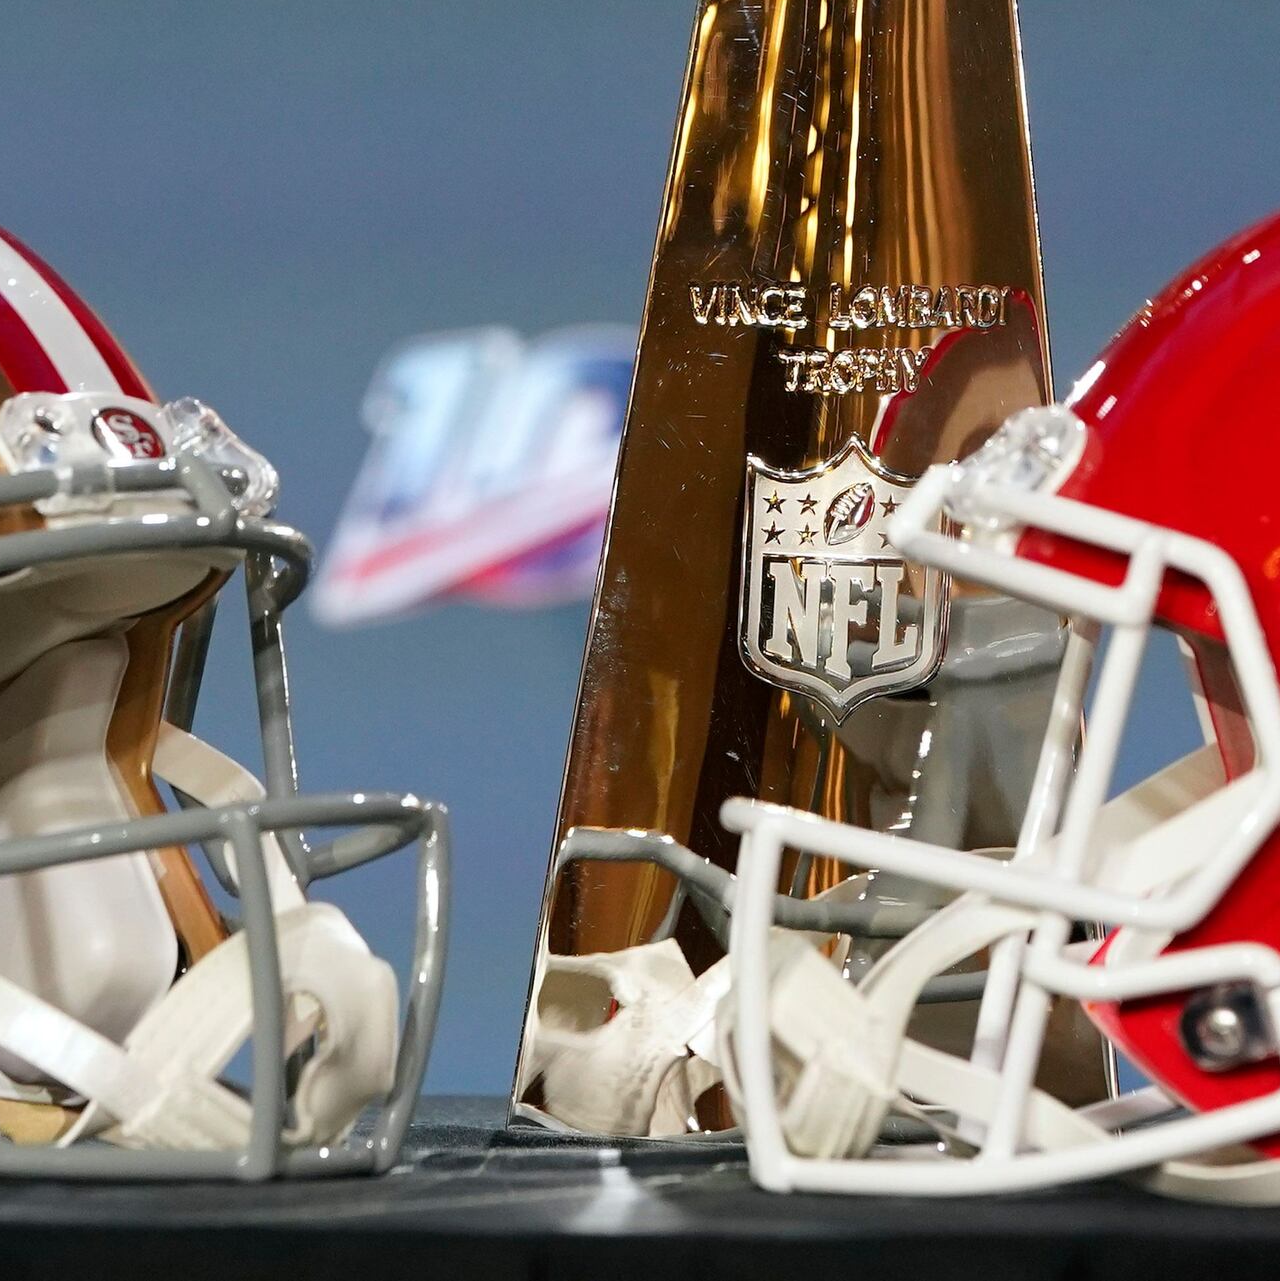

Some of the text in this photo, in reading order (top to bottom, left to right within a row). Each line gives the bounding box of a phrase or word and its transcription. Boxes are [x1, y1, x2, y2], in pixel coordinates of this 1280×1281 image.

[687, 279, 1012, 330] VINCE LOMBARDI
[776, 345, 934, 395] TROPHY
[763, 560, 920, 682] NFL
